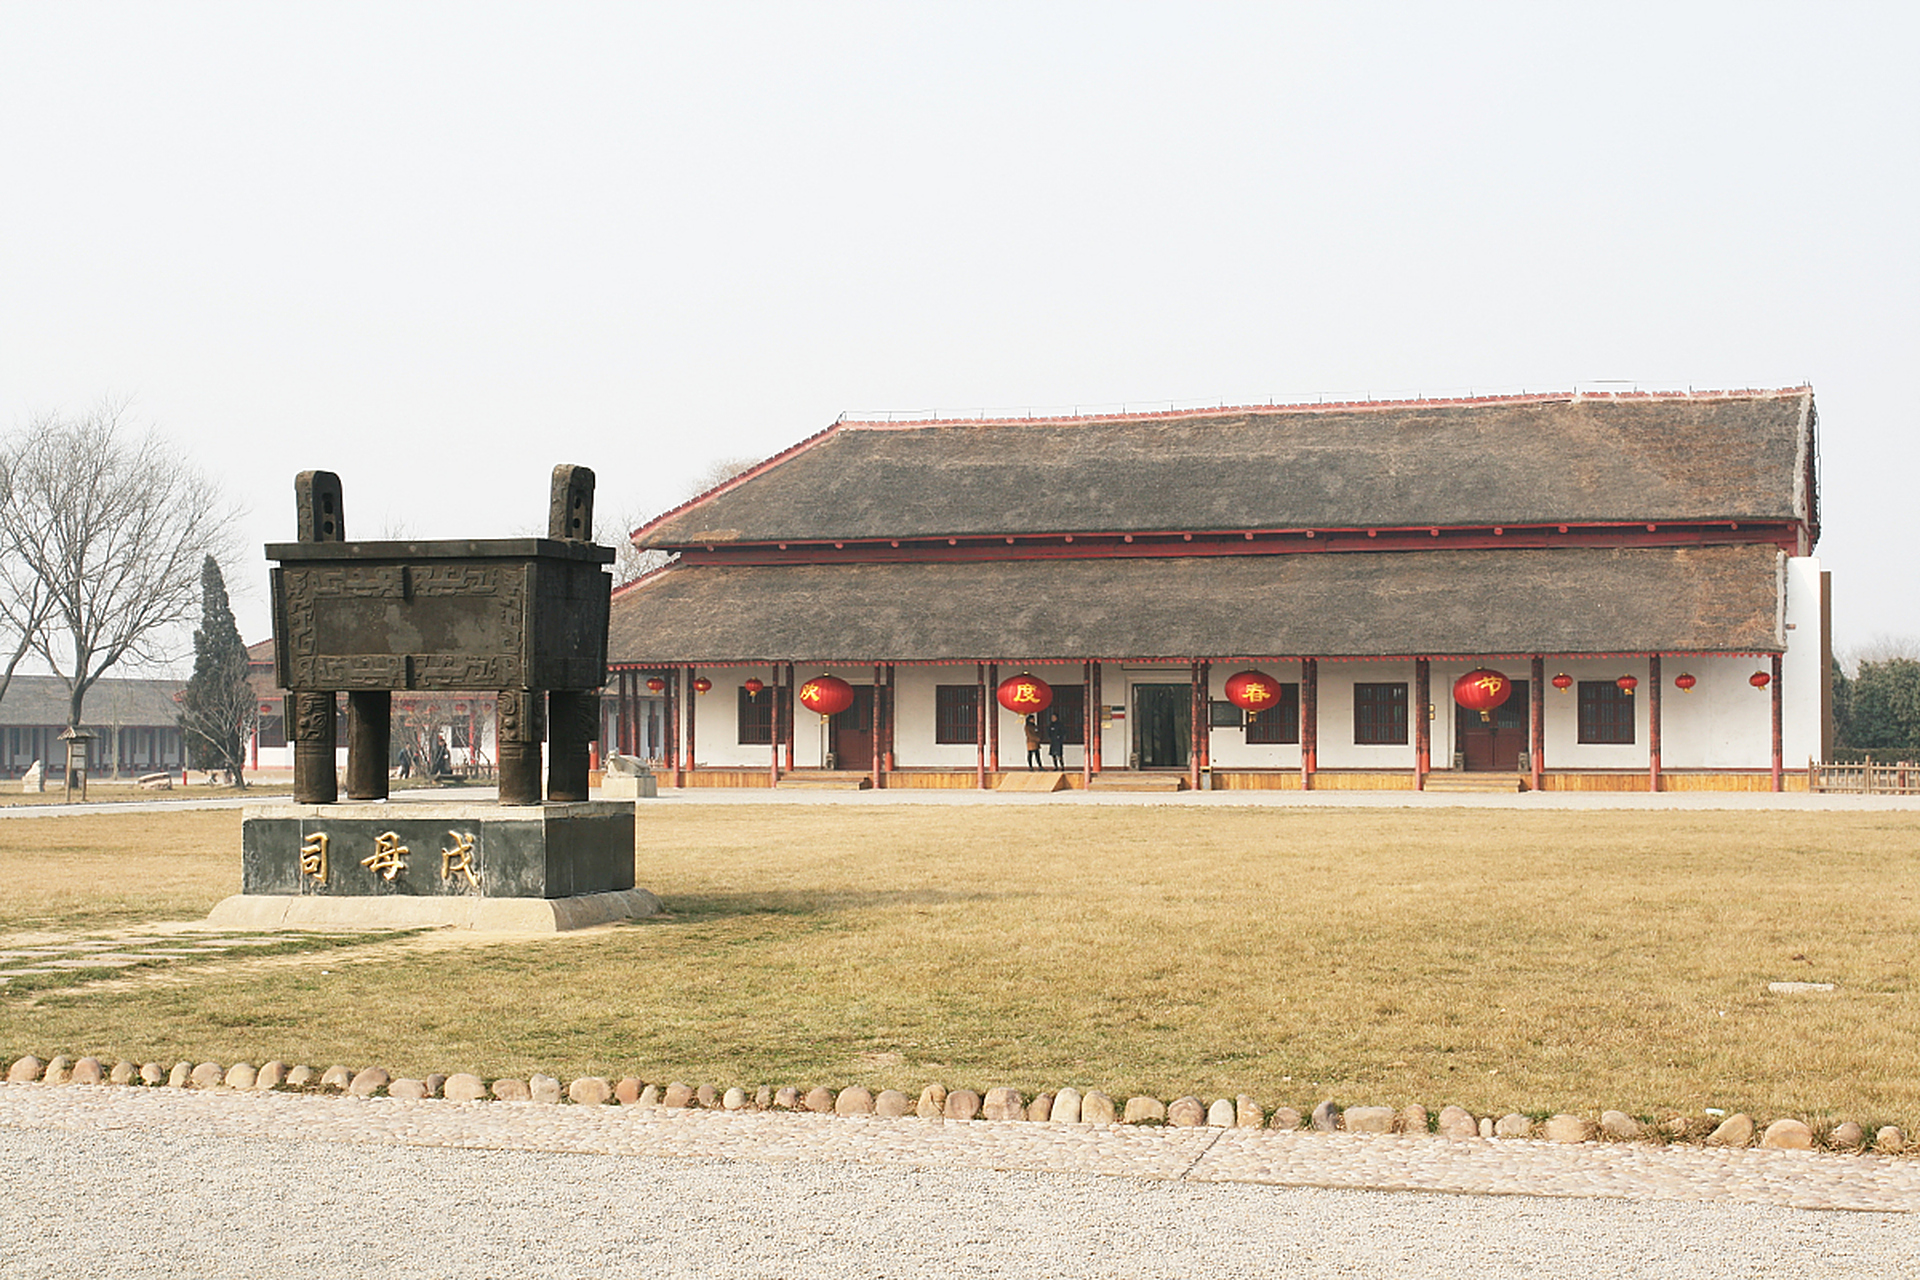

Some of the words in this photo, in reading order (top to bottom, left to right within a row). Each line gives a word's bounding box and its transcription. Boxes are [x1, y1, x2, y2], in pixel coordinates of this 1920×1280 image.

[1013, 683, 1041, 703] 度
[1242, 683, 1271, 702] 春
[1475, 676, 1503, 696] 节
[301, 831, 479, 887] 司母戊
